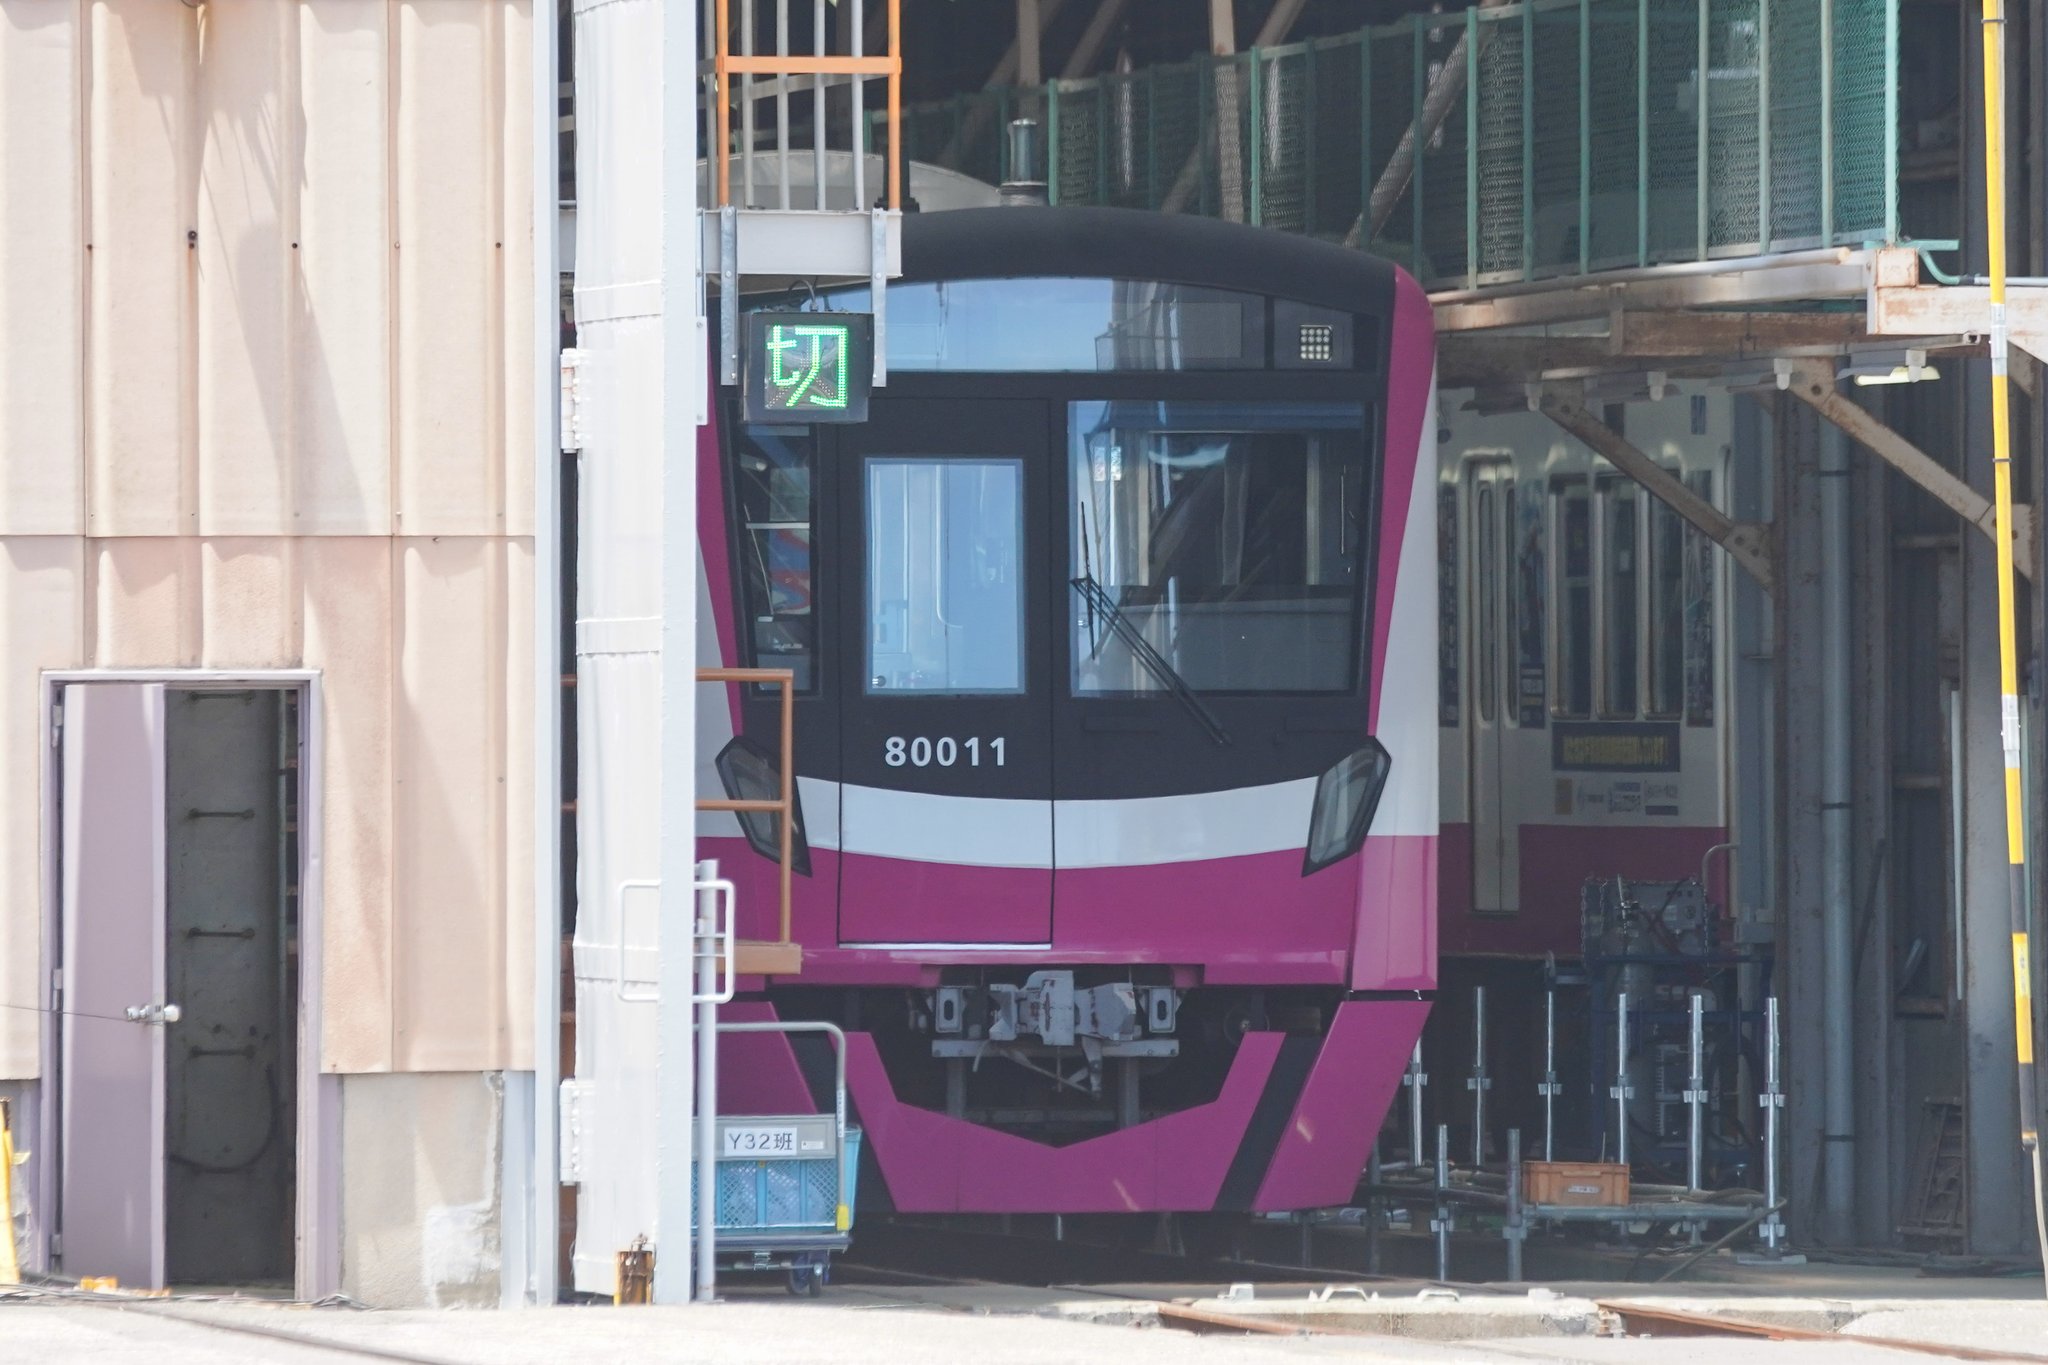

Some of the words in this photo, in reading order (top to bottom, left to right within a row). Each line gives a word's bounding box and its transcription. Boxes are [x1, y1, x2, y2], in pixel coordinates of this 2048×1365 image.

[766, 325, 847, 407] 切
[885, 736, 1005, 767] 80011
[728, 1132, 793, 1151] Y32班
